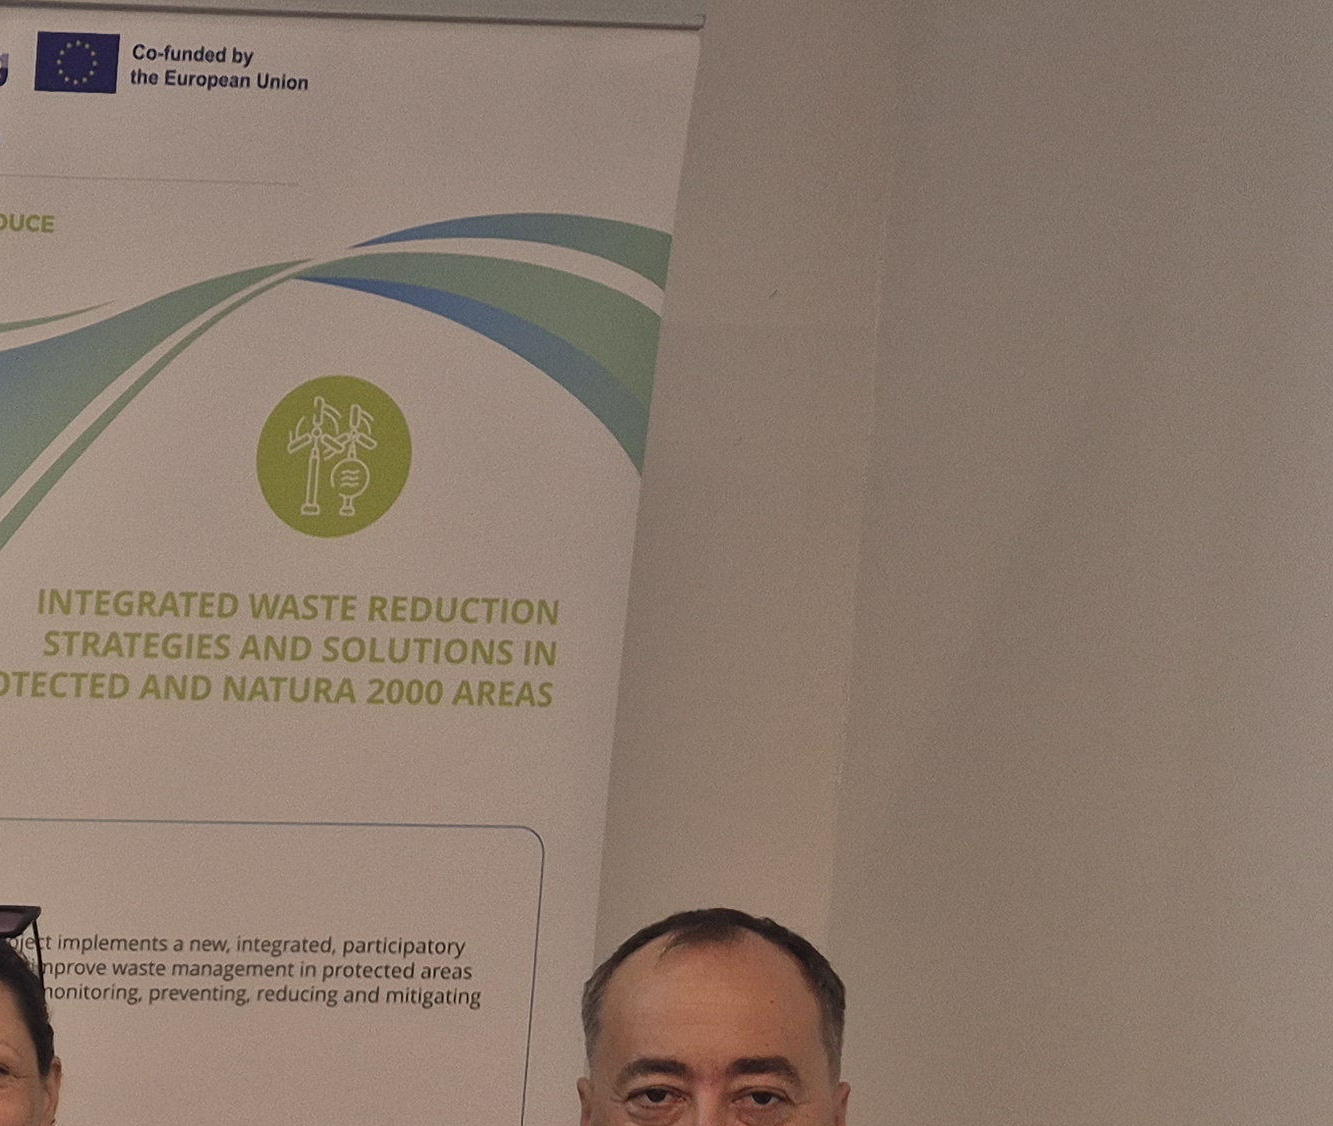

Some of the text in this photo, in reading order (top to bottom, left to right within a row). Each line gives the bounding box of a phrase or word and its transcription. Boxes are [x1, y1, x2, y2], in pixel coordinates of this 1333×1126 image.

[132, 44, 254, 68] Co-funded by
[130, 69, 309, 92] the European Union
[36, 588, 560, 626] INTEGRATED WASTE REDUCTION
[43, 630, 558, 667] STRATEGIES AND SOLUTIONS IN
[139, 673, 212, 701] AND
[222, 675, 356, 704] NATURA
[365, 678, 444, 705] 2000
[452, 680, 554, 708] AREAS
[58, 933, 168, 955] implements
[173, 938, 184, 953] a
[189, 939, 231, 955] new,
[236, 935, 337, 957] integrated,
[342, 936, 467, 959] participatory
[112, 960, 166, 977] waste
[171, 961, 295, 982] management
[299, 961, 317, 978] in
[321, 961, 415, 982] protected
[420, 965, 473, 981] areas
[148, 985, 251, 1007] preventing,
[256, 985, 338, 1008] reducing
[343, 986, 380, 1004] and
[385, 987, 482, 1010] mitigating
